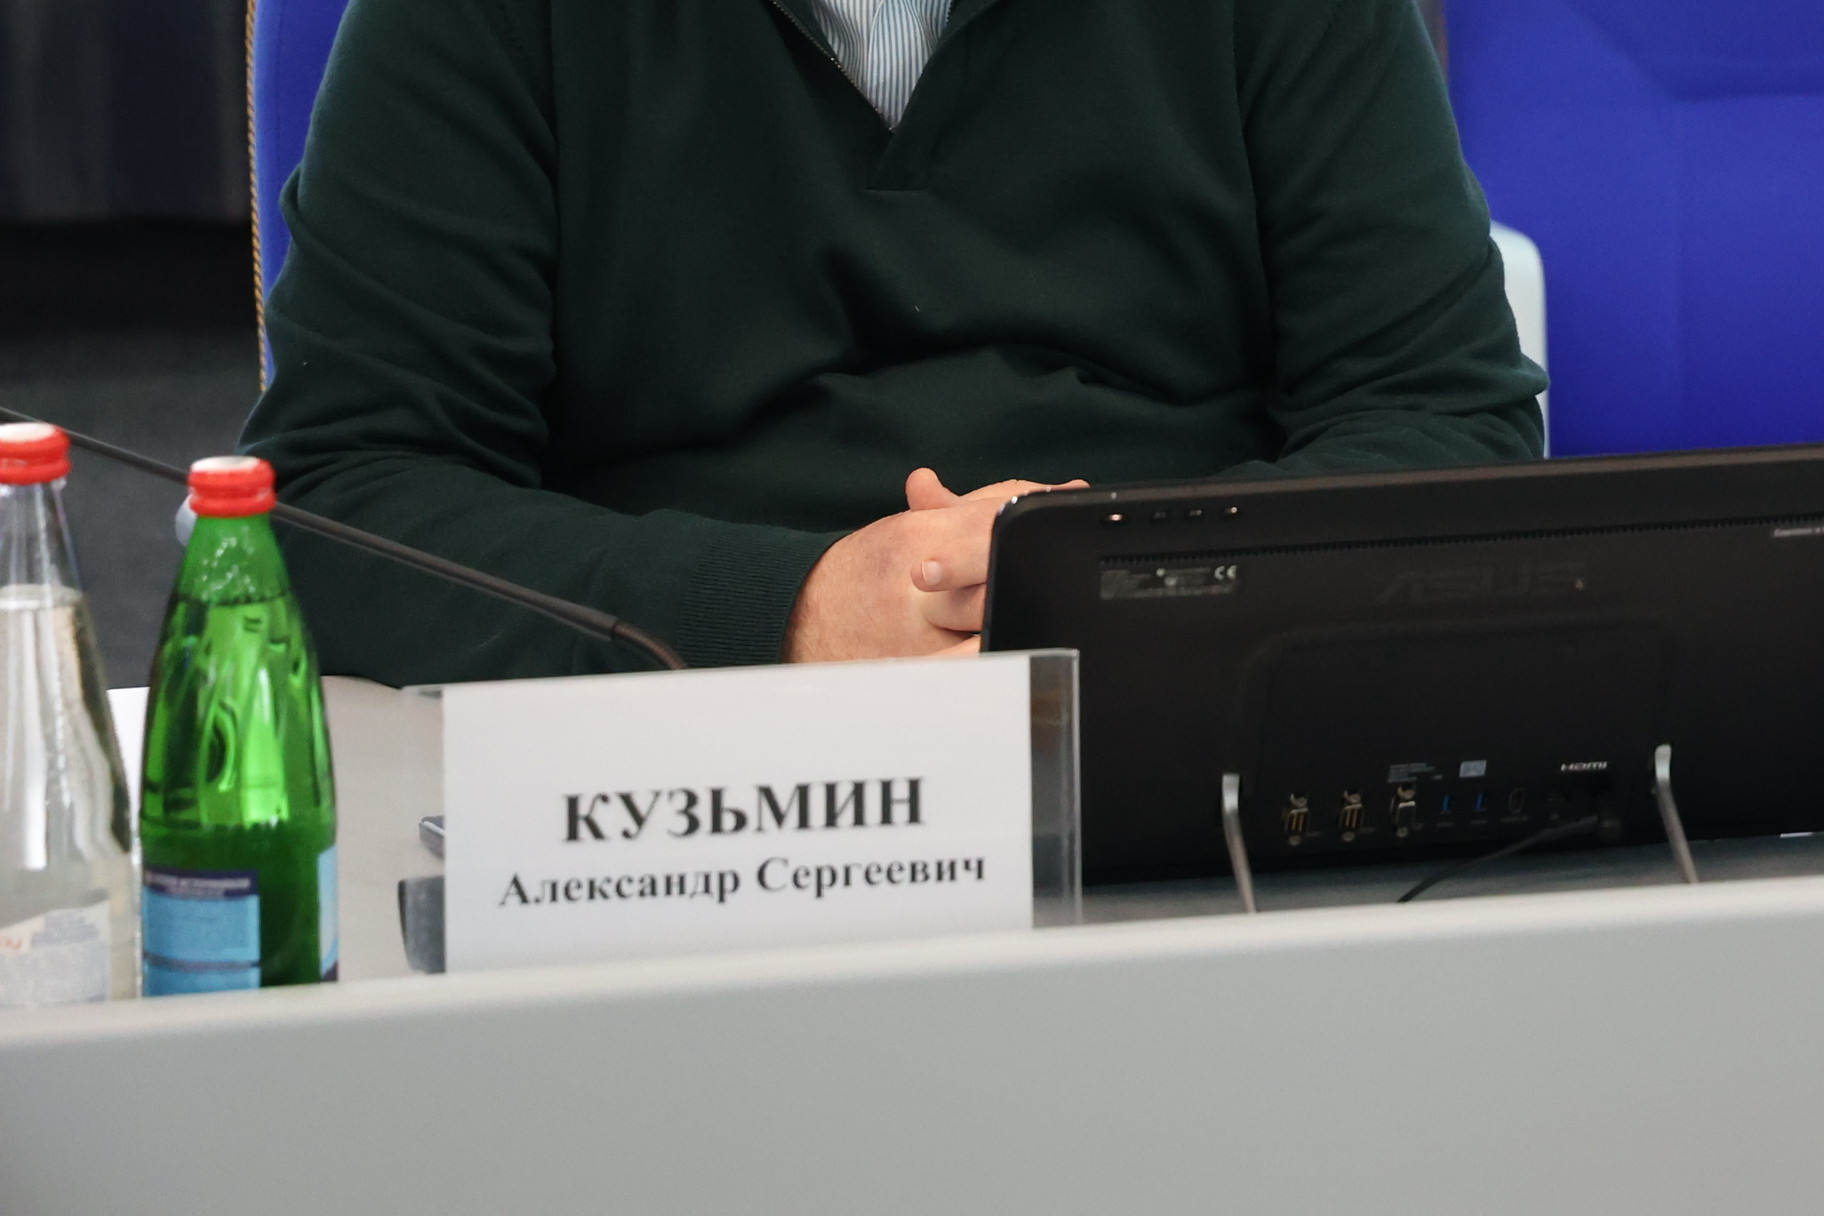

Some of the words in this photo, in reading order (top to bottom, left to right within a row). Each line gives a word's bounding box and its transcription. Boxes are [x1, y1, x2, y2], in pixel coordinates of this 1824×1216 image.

[563, 777, 924, 843] КУЗЬМИН
[499, 870, 741, 906] Александр
[756, 858, 986, 898] Сергеевич
